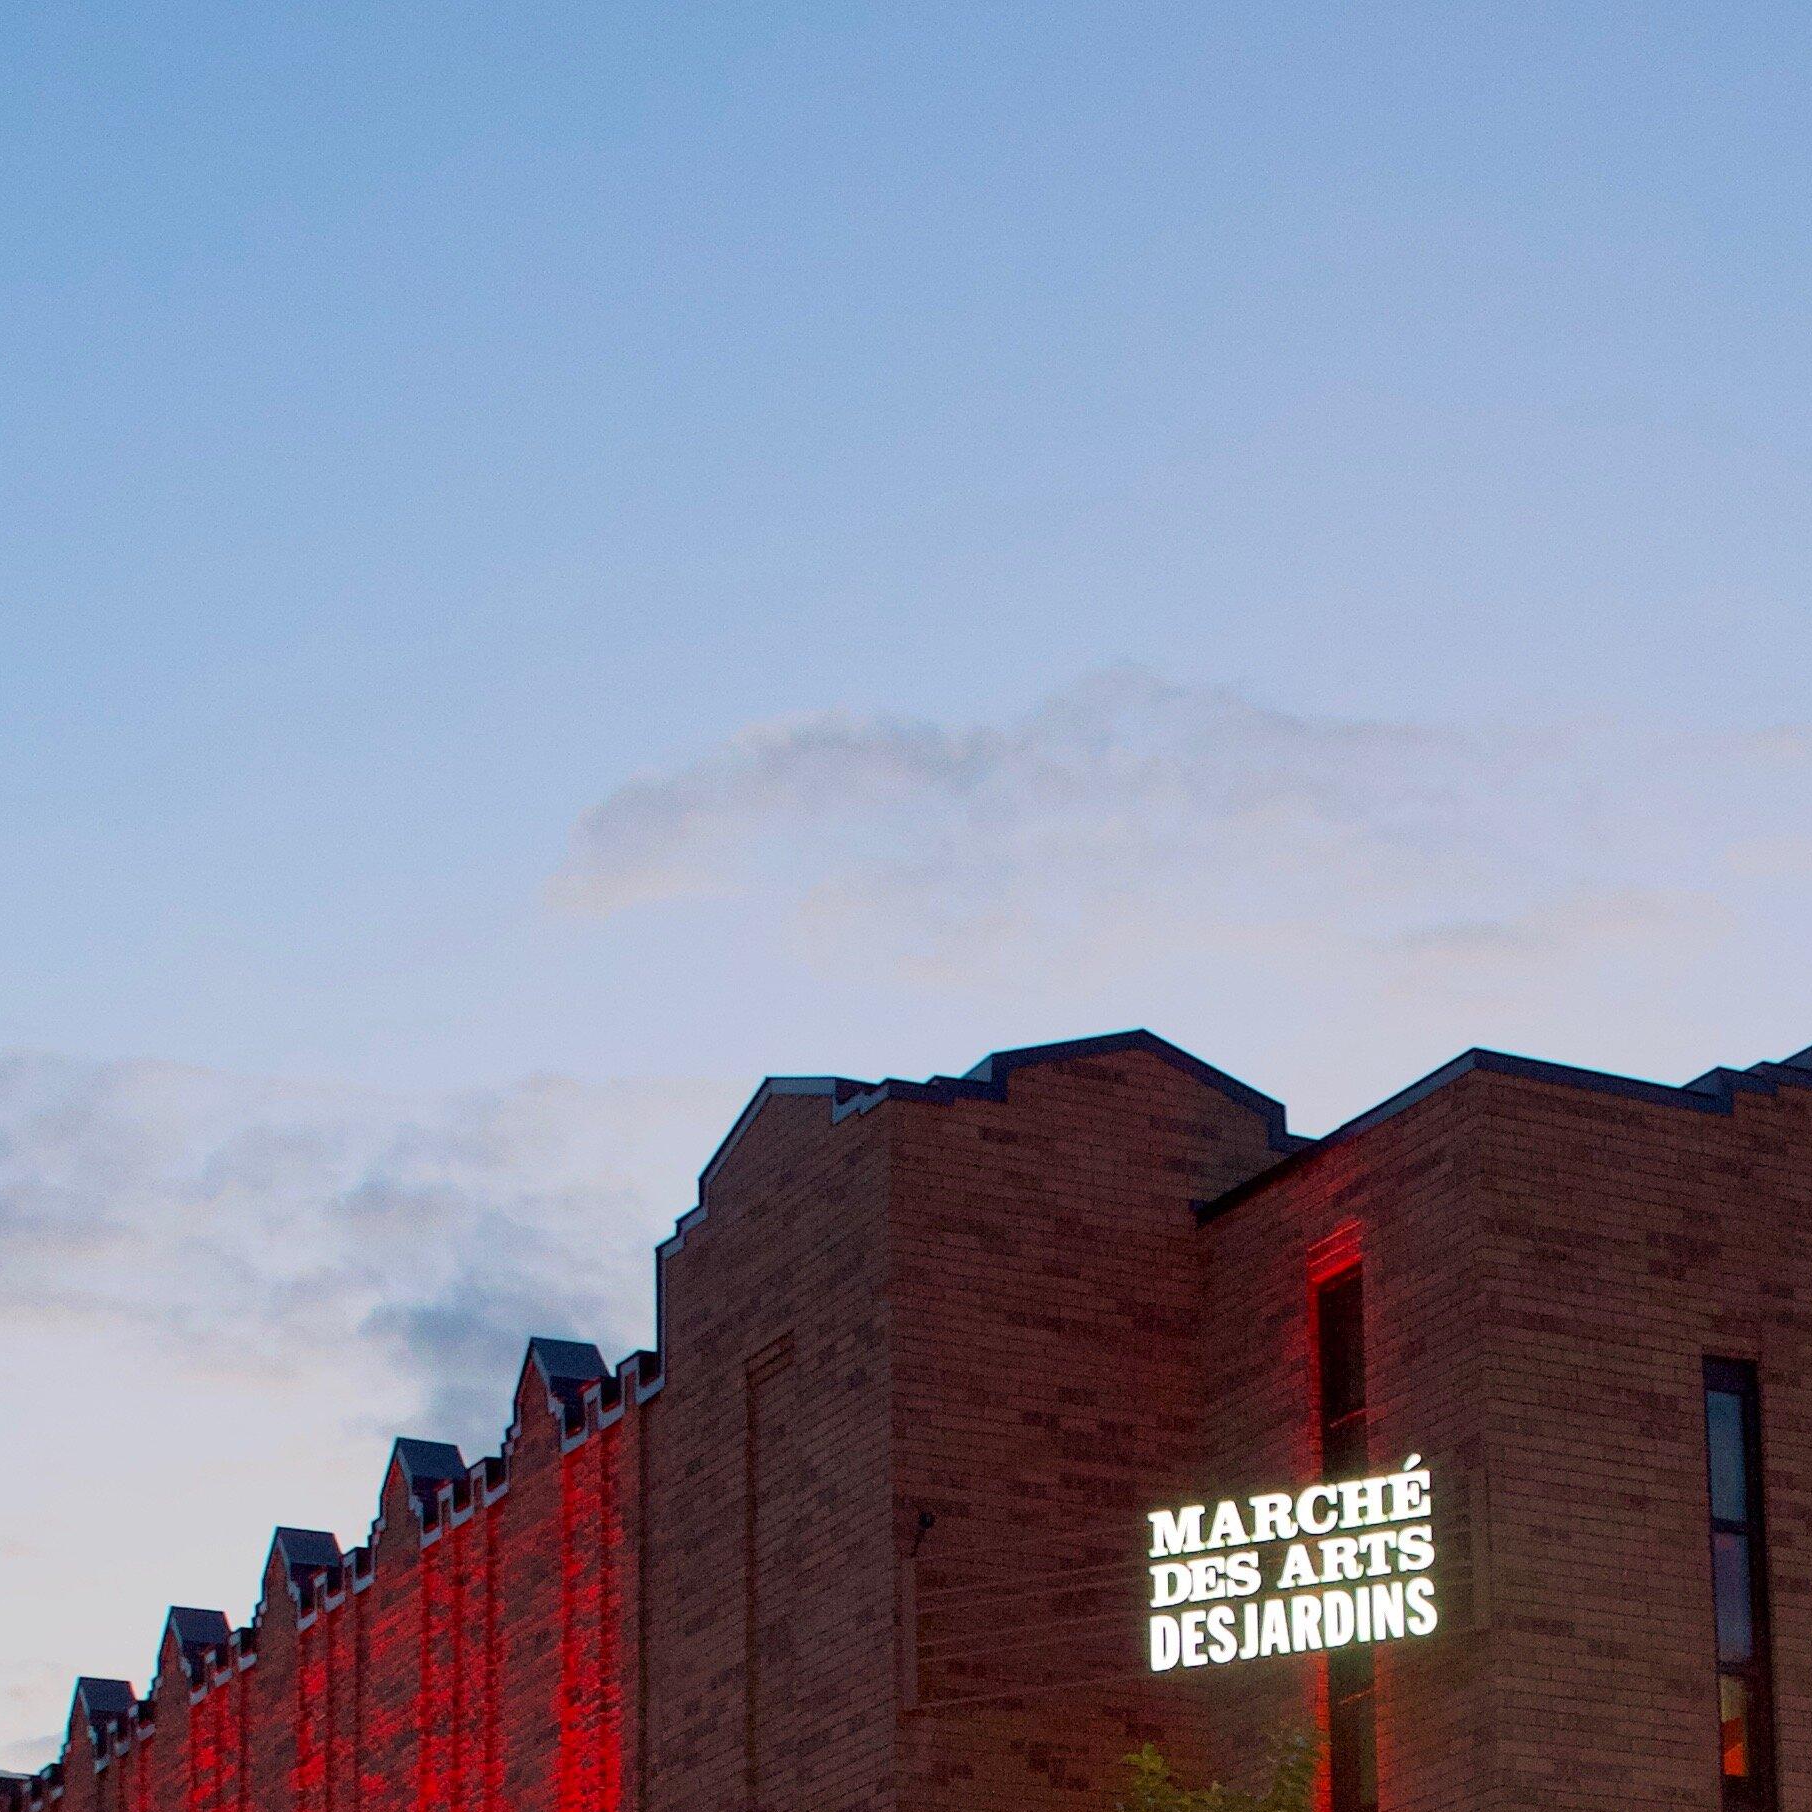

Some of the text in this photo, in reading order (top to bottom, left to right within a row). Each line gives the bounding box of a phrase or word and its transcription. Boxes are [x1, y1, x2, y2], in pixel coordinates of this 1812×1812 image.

[1147, 1453, 1432, 1558] MARCHÉ
[1149, 1524, 1436, 1608] DES ARTS
[1149, 1576, 1438, 1672] DESJARDINS
